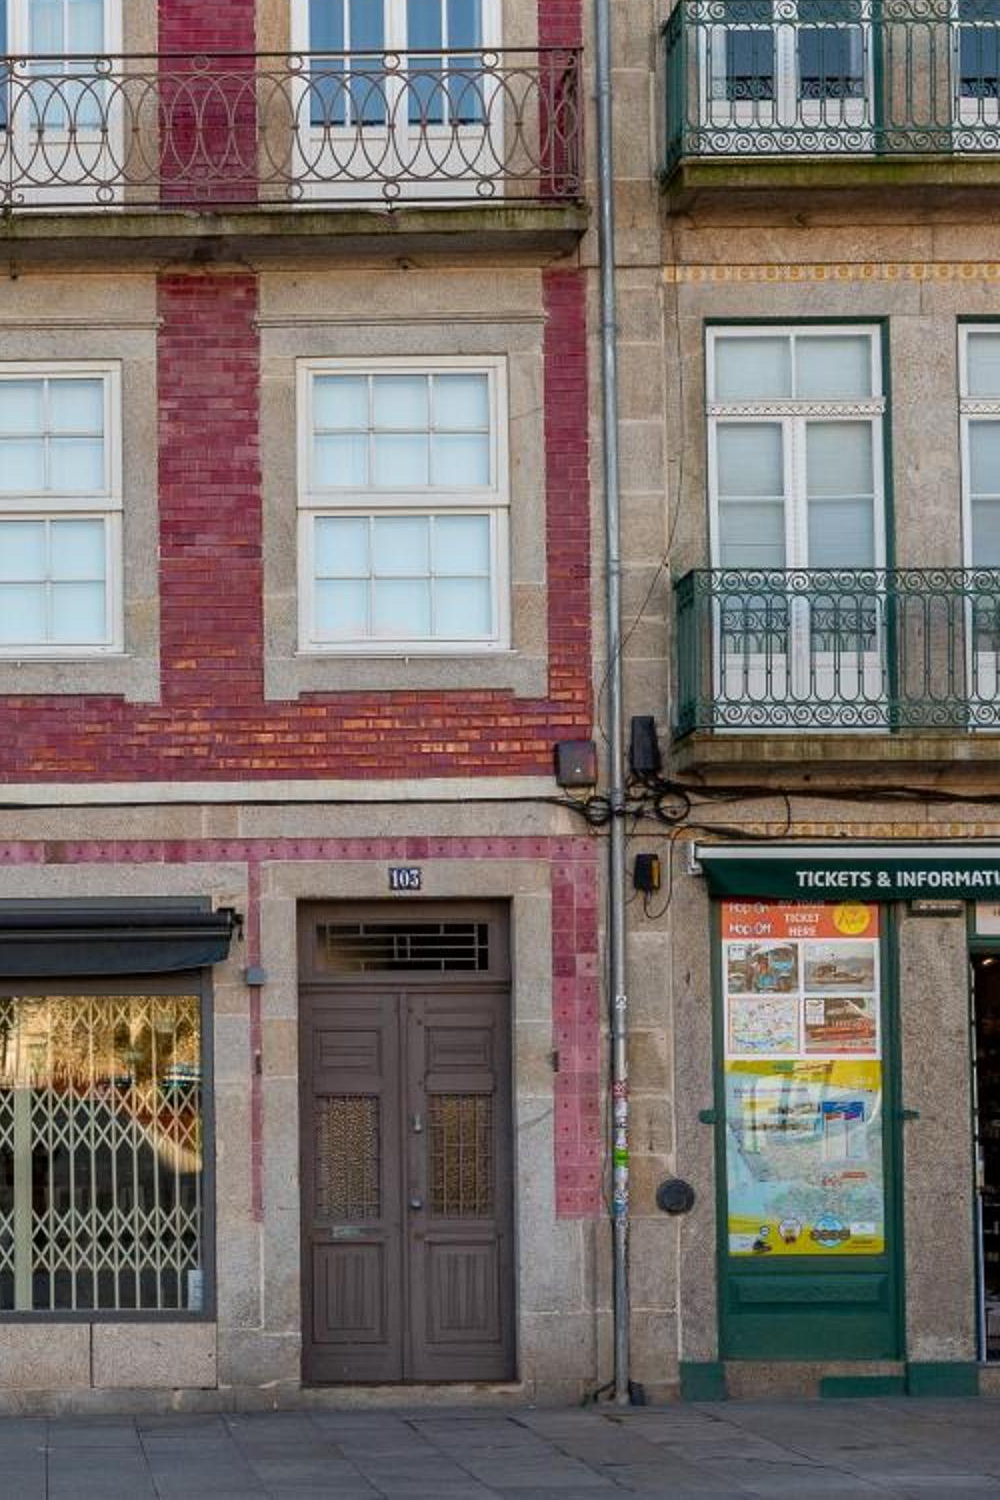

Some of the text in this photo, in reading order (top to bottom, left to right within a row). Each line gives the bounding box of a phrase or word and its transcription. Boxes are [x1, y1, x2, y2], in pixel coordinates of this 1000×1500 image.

[796, 870, 1000, 887] TICKETS & INFORMATI
[784, 913, 820, 923] TICKET
[788, 926, 817, 937] HERE
